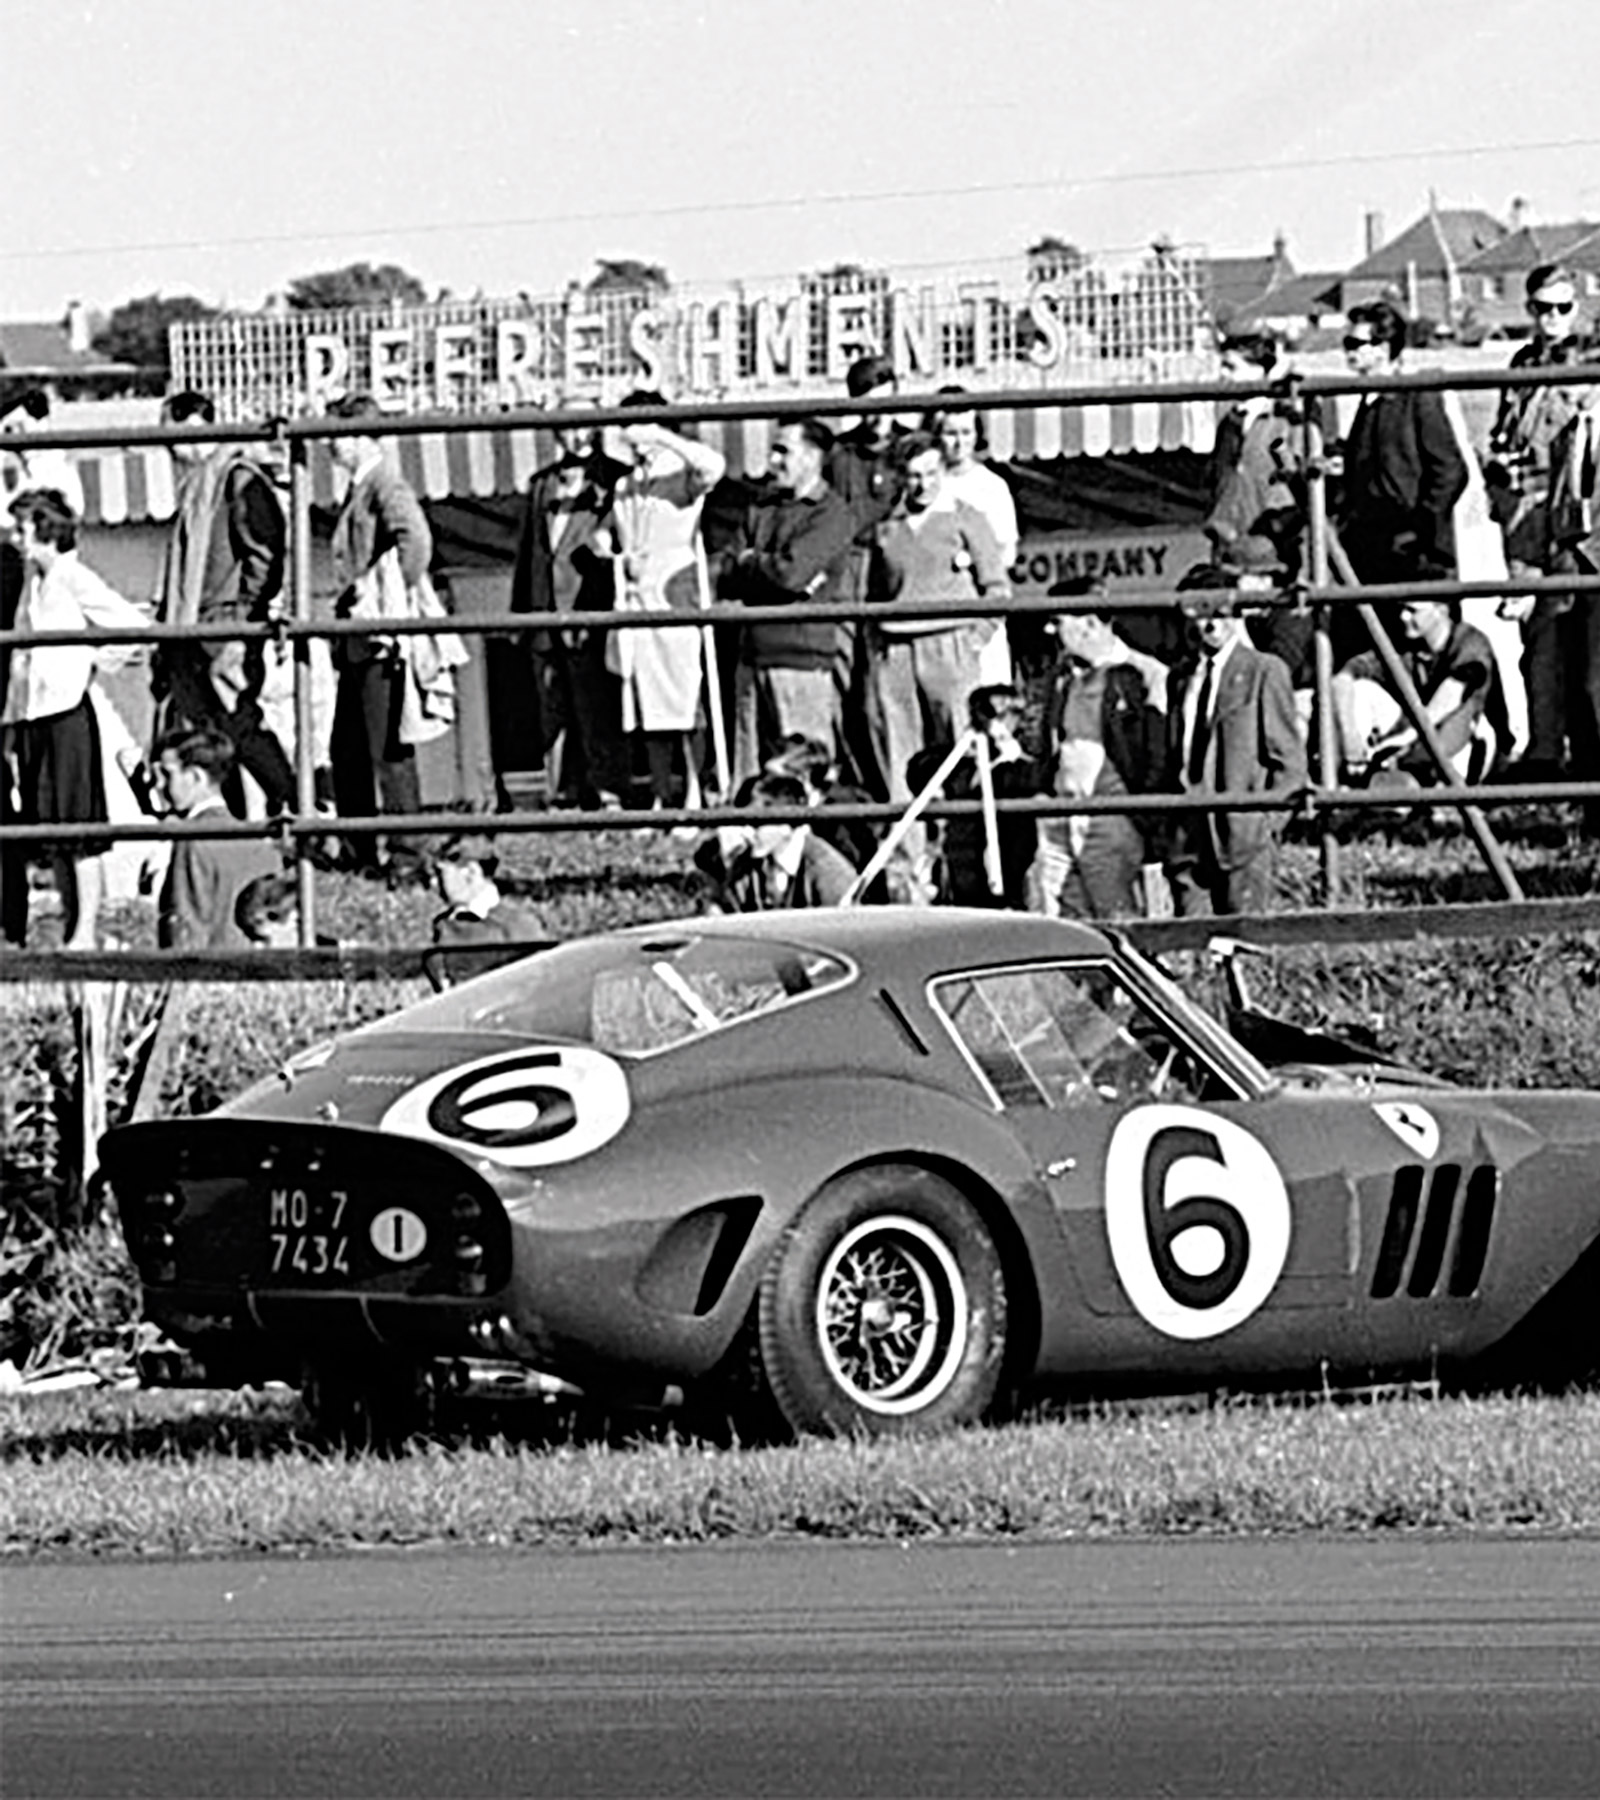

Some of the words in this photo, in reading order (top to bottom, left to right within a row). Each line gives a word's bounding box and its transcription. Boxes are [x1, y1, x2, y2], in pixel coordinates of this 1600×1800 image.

[304, 281, 1067, 417] REFRESHMENTS
[1007, 545, 1168, 585] COMPANY
[426, 1052, 577, 1148] 6
[270, 1233, 349, 1274] 7434
[1141, 1124, 1251, 1311] 6
